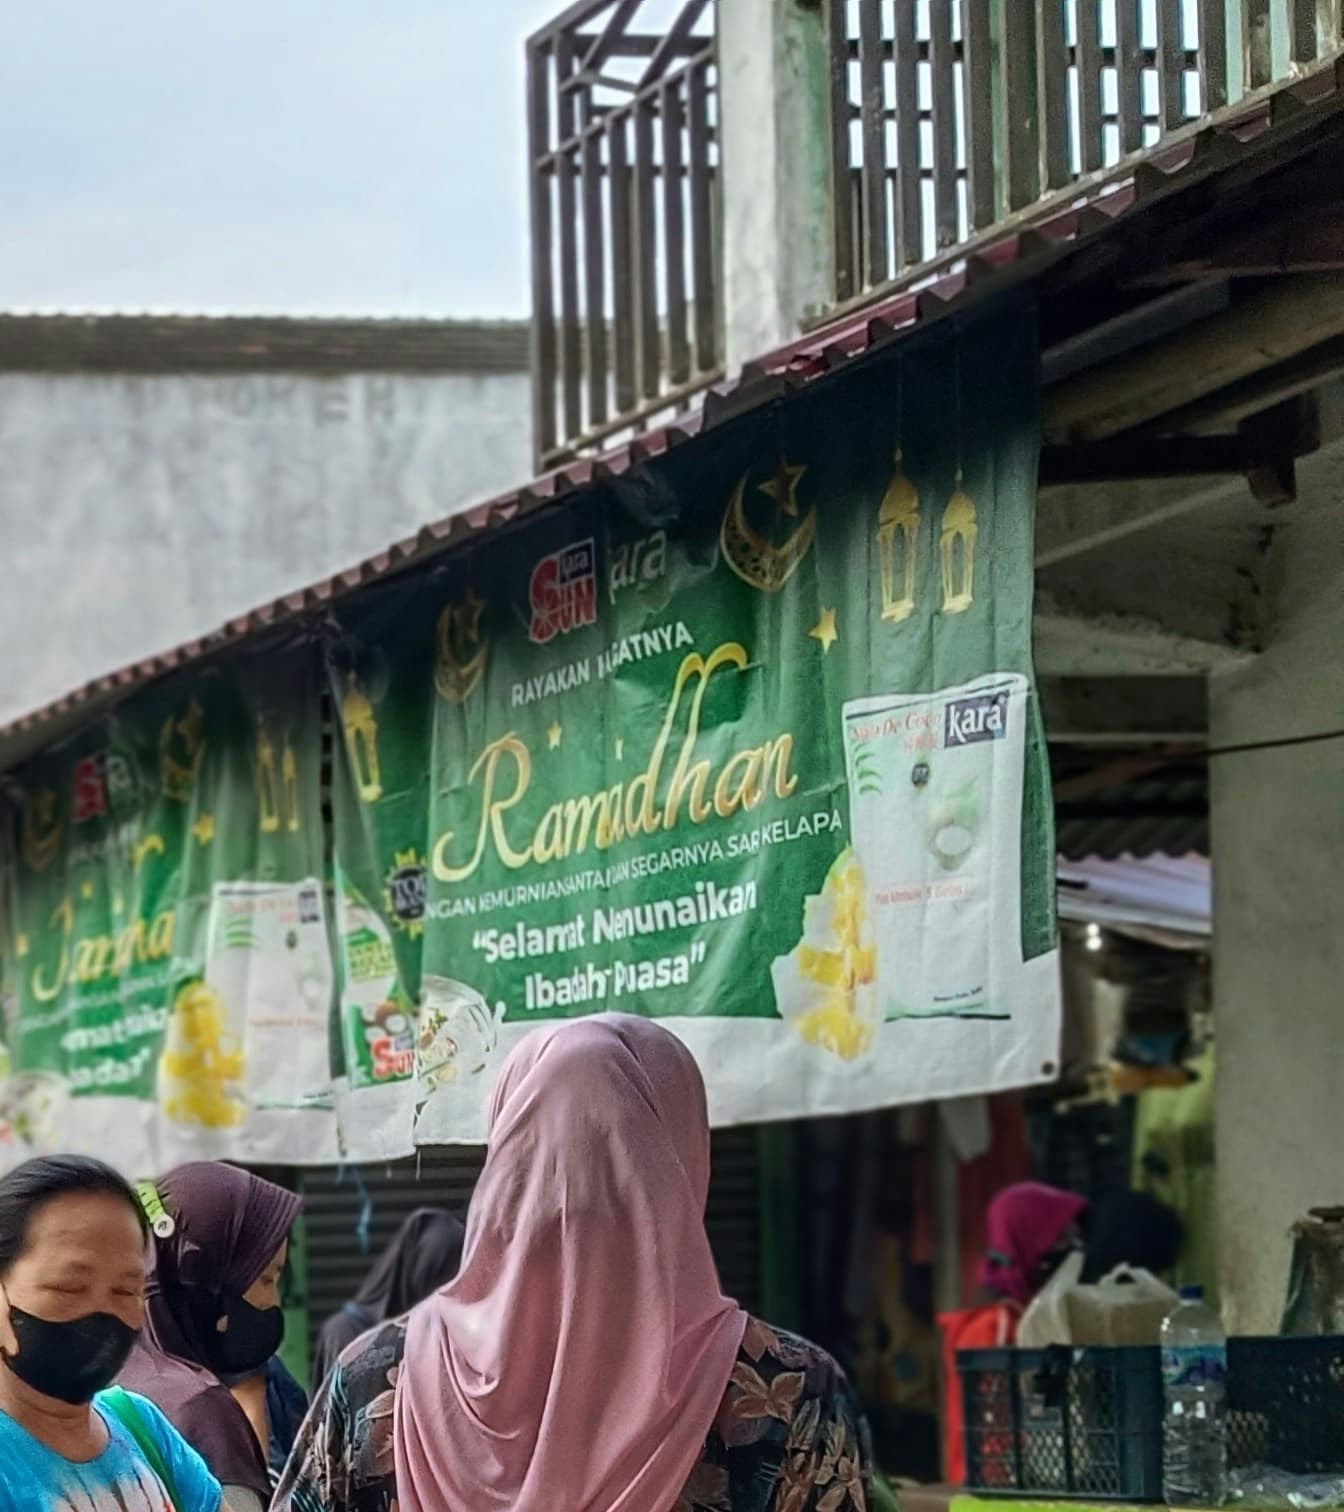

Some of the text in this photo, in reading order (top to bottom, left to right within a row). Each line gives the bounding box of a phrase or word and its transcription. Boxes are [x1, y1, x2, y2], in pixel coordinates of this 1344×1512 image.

[511, 658, 591, 707] RAYAKAN
[949, 703, 1003, 743] kara
[431, 641, 799, 882] Ramadhan
[423, 896, 476, 921] NGAN
[631, 839, 724, 880] SEGARNYA
[727, 830, 759, 858] SAR
[760, 808, 843, 845] KELAPA
